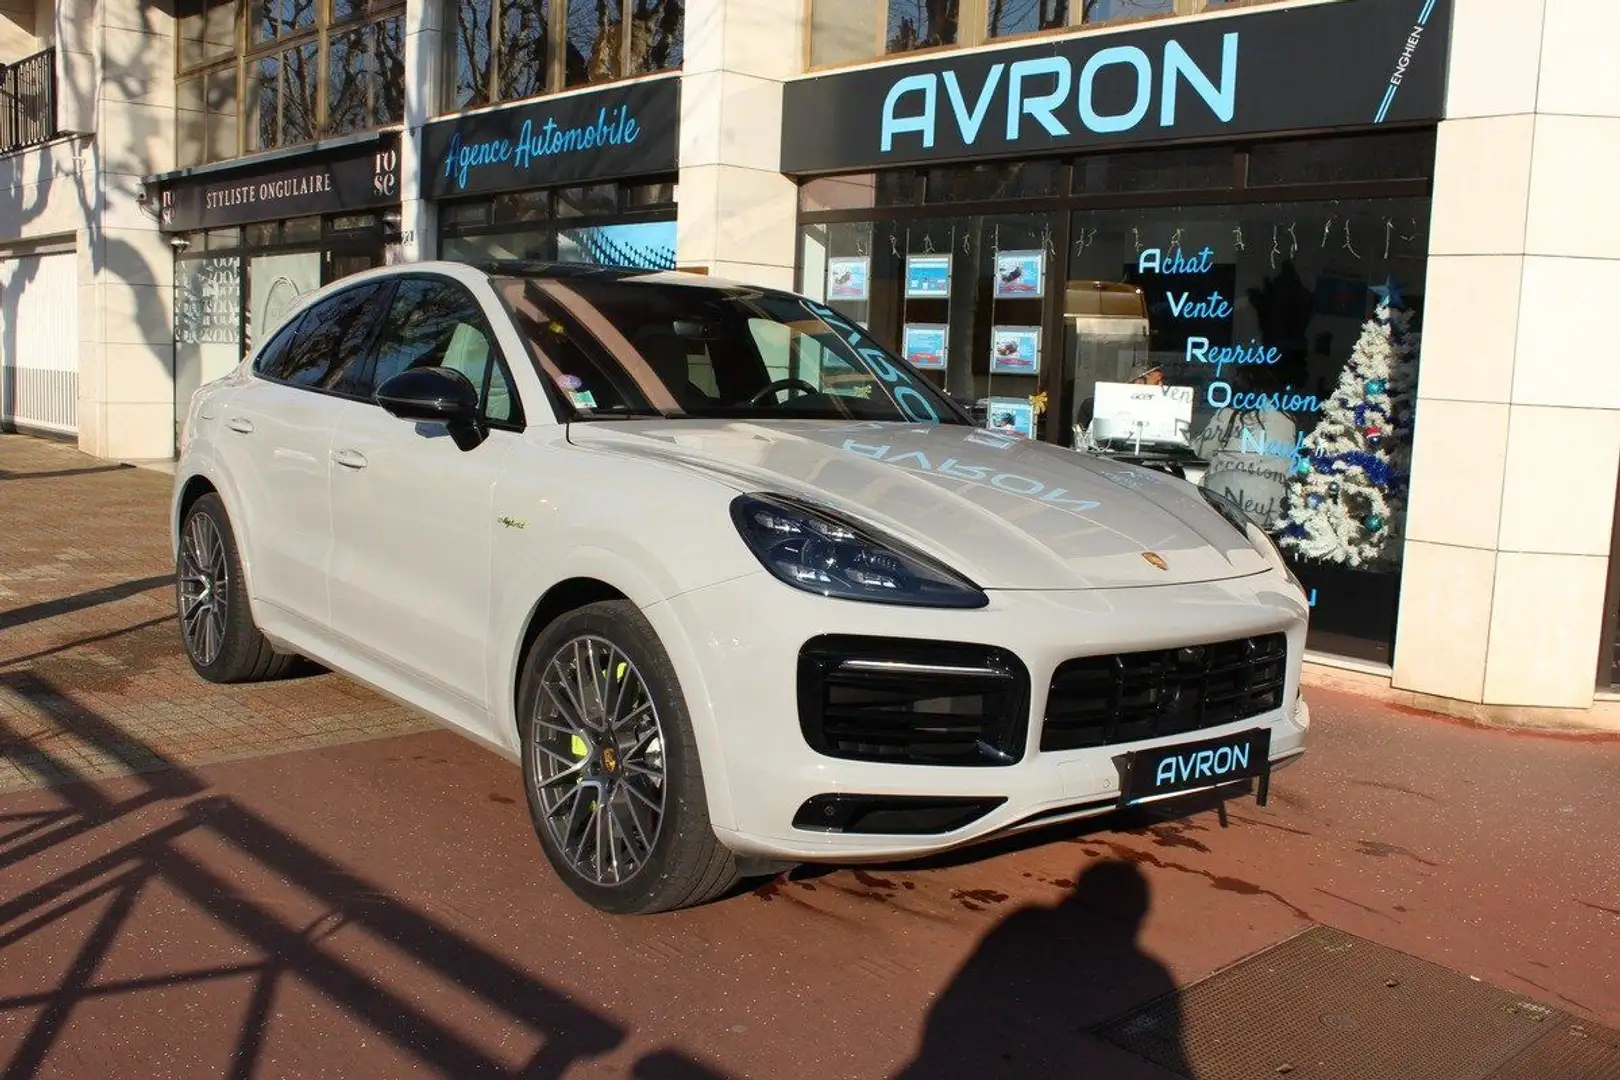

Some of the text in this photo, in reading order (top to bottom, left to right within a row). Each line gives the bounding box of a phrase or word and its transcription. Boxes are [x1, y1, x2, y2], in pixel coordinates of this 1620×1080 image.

[1390, 25, 1424, 85] ENGHIEN
[880, 32, 1239, 152] AVRON
[445, 104, 641, 188] Agence Automobile
[206, 172, 332, 209] STYLISTE ONGULAIRE
[1138, 246, 1214, 274] Achat
[1166, 291, 1233, 318] Vente
[1185, 337, 1282, 378] Reprise
[1207, 381, 1323, 412] Occasion
[1240, 425, 1307, 475] Neuf
[1156, 742, 1250, 787] AVRON
